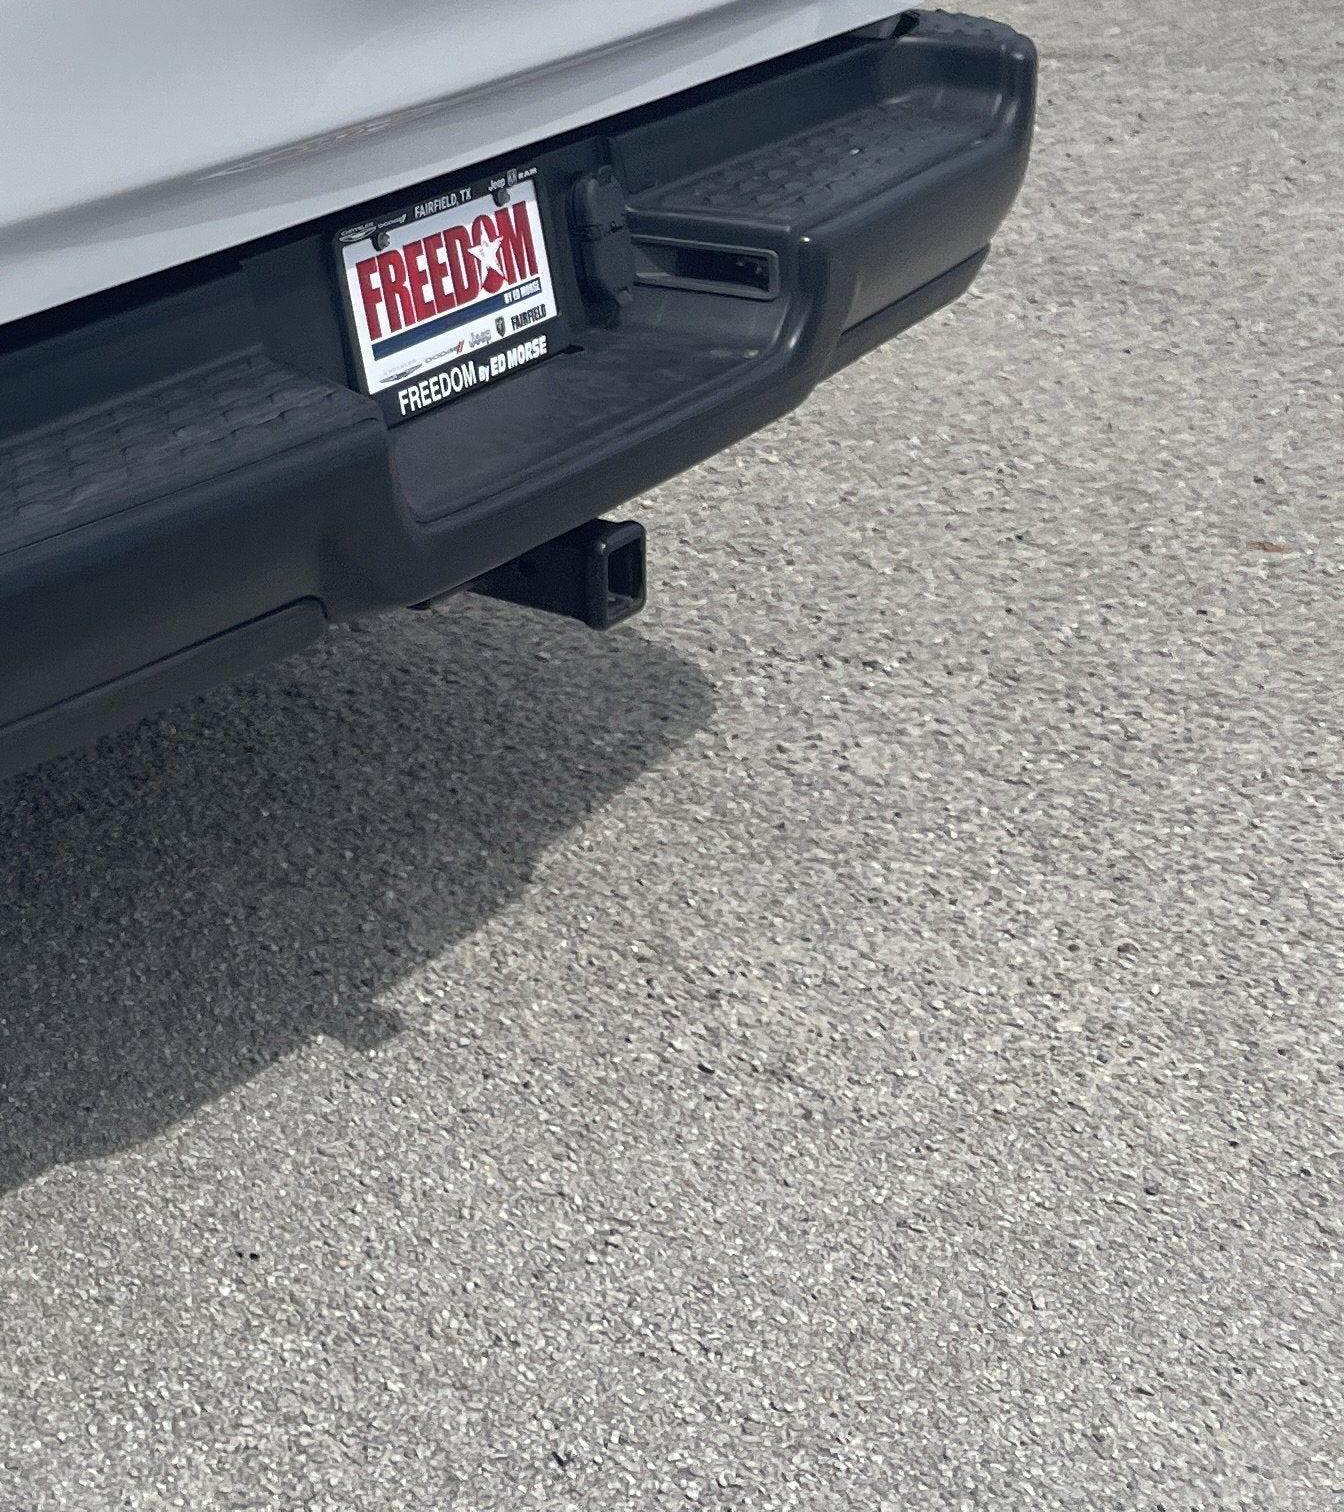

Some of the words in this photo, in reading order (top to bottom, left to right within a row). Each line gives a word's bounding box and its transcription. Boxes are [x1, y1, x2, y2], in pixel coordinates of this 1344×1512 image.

[518, 168, 538, 180] RAM
[414, 193, 459, 219] FAIRFIELD,
[460, 187, 472, 201] TX
[355, 200, 539, 342] FREEDOM
[511, 303, 547, 331] FAIRFIELD
[398, 360, 477, 416] FREEDOM
[490, 353, 507, 377] ED
[506, 335, 548, 369] MORSE
